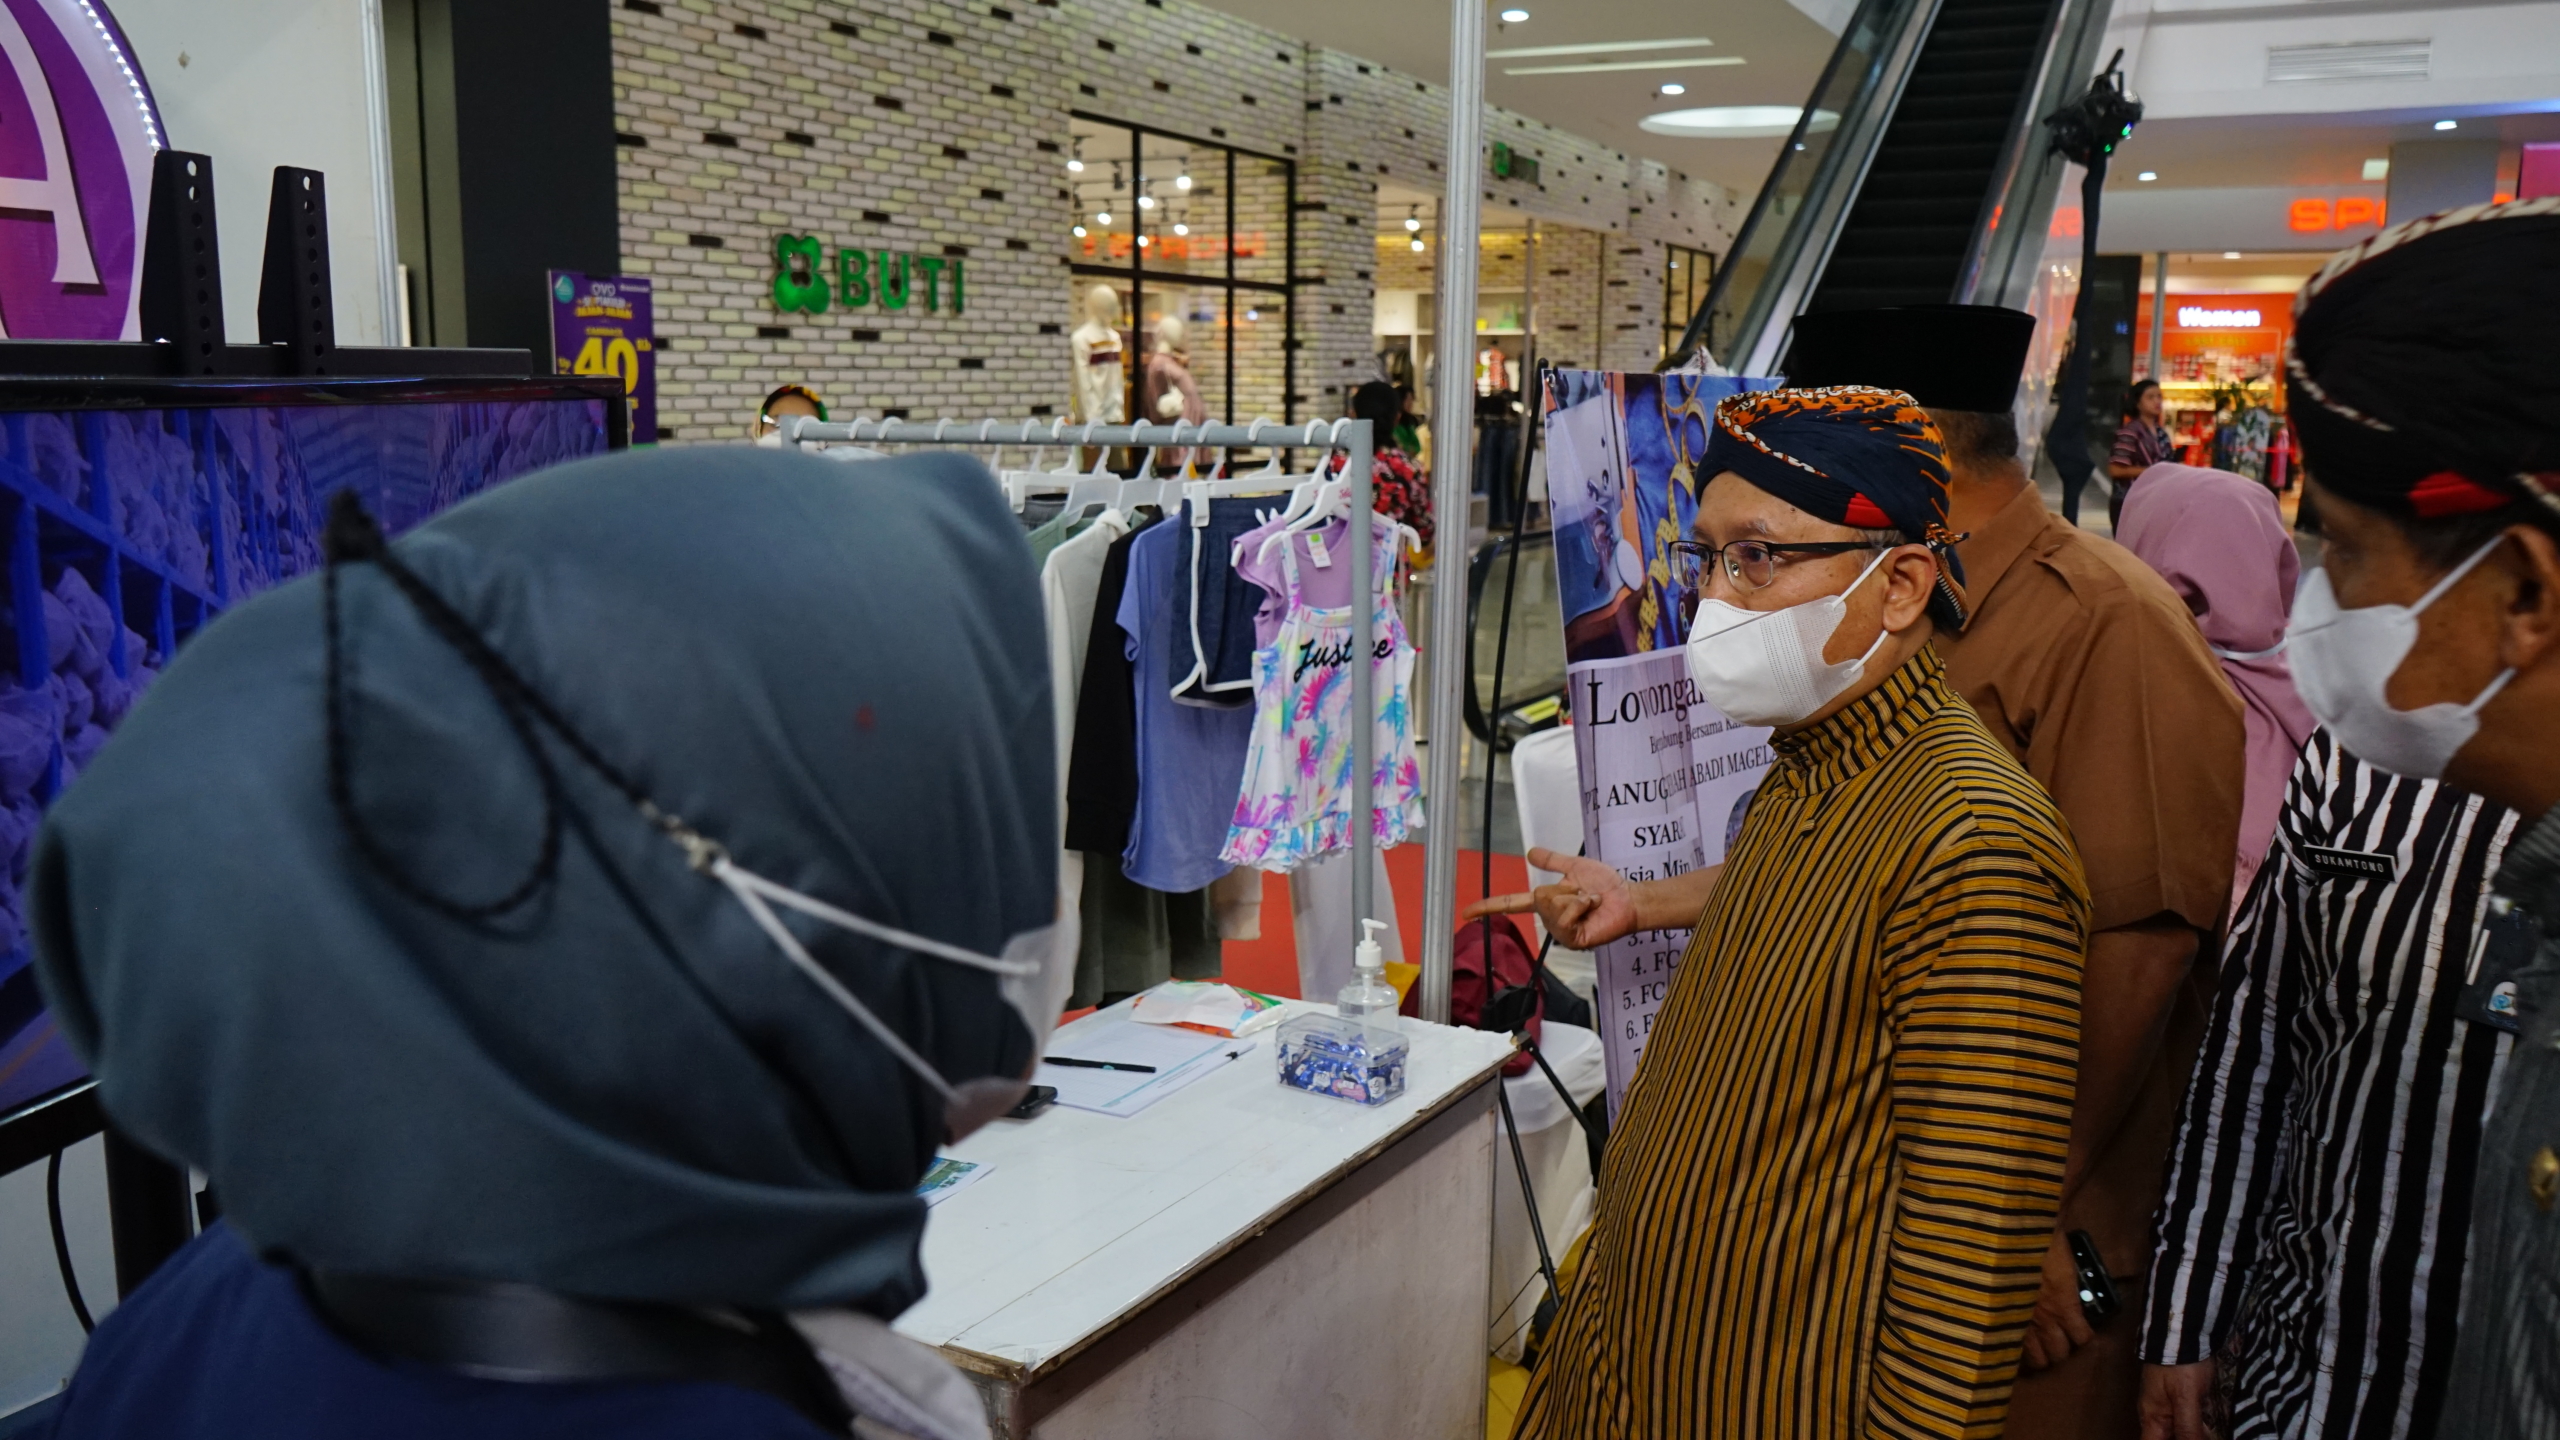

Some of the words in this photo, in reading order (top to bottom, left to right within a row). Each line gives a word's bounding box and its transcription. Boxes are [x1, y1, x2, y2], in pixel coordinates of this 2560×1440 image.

[840, 249, 964, 313] BUTI
[574, 336, 639, 395] 40
[1293, 635, 1393, 683] Juste
[1686, 720, 1724, 742] Bersama
[1689, 755, 1724, 788] ABADI
[2314, 853, 2384, 873] SUKAMTONO
[1631, 956, 1647, 976] 4.
[1653, 949, 1681, 972] FC
[1622, 990, 1636, 1010] 5.
[1640, 981, 1666, 1005] FC
[1625, 1019, 1638, 1041] 6.
[1643, 1012, 1658, 1035] F
